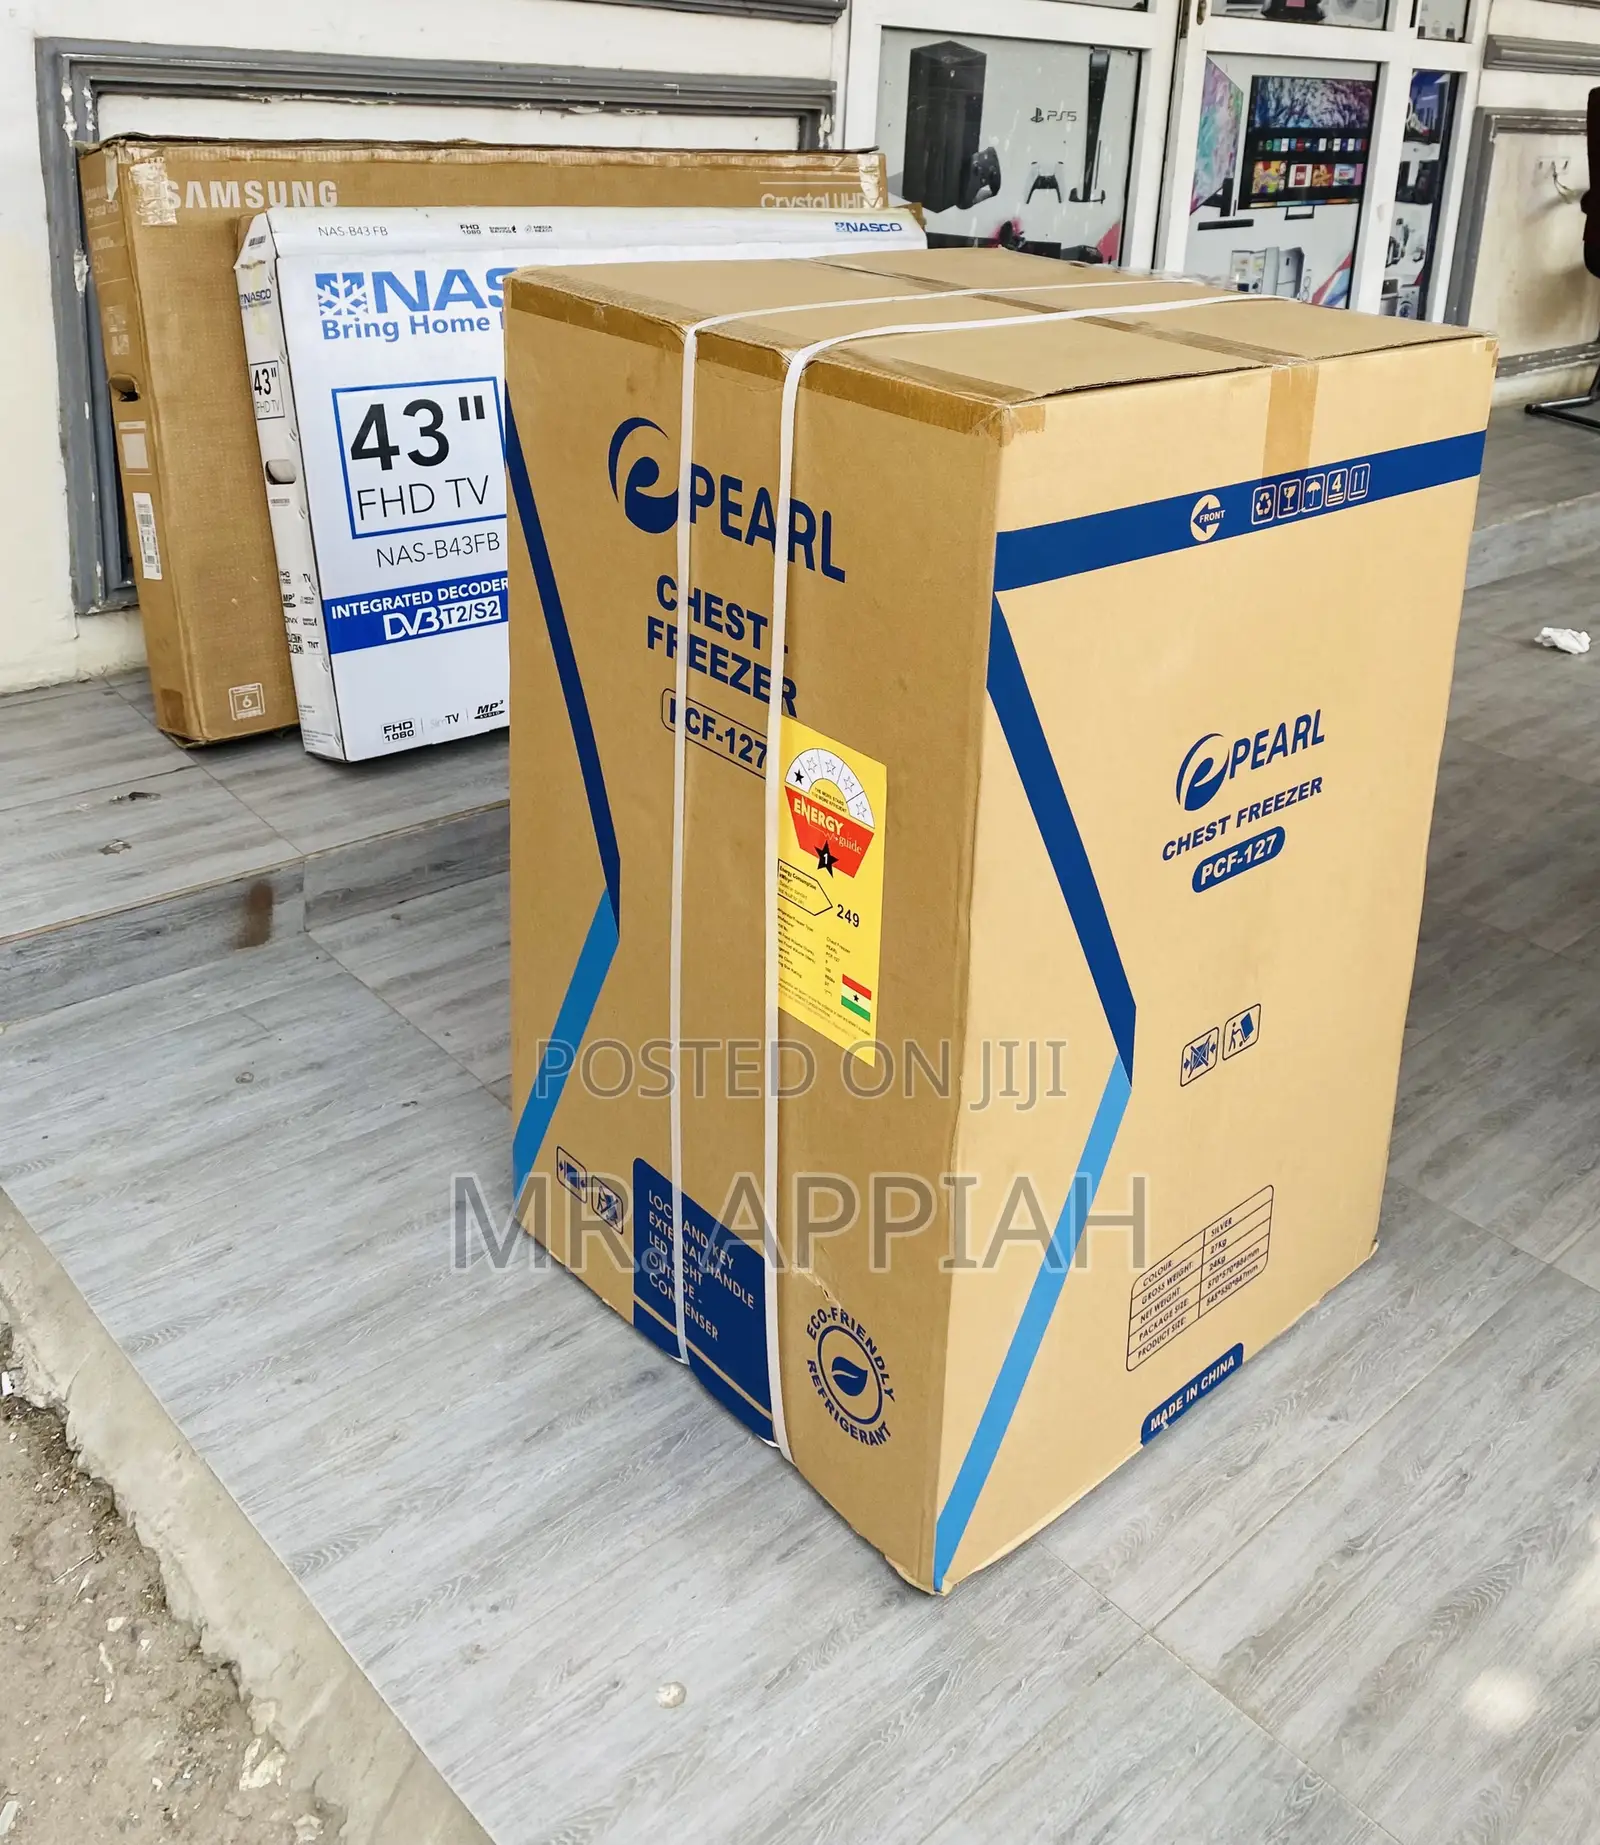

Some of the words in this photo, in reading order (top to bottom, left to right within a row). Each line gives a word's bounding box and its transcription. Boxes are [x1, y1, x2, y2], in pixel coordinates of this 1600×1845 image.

[1047, 110, 1077, 122] PS5
[165, 180, 338, 209] SAMSUNG
[846, 222, 902, 232] NASCO
[243, 289, 272, 304] NASCO
[321, 317, 400, 343] Bring
[409, 315, 491, 336] Home
[254, 367, 277, 396] 43"
[350, 395, 486, 471] 43"
[357, 483, 435, 520] FHD
[445, 475, 489, 508] TV
[1199, 509, 1226, 524] FRONT
[689, 462, 846, 584] PEARL
[376, 531, 500, 568] NAS-B43FB
[331, 590, 433, 620] INTEGRATED
[438, 577, 508, 602] DECODER
[382, 606, 441, 640] DVB
[443, 600, 499, 625] T2/S2
[383, 720, 413, 735] FHD
[384, 729, 415, 742] 1080
[1228, 709, 1326, 780] PEARL
[794, 796, 844, 836] ENERGY
[1162, 815, 1231, 861] CHEST
[1236, 776, 1323, 829] FREEZER
[823, 853, 829, 865] 1
[838, 836, 862, 855] guide
[1200, 833, 1277, 885] PCF-127
[837, 904, 860, 928] 249
[648, 1189, 673, 1220] LOC
[683, 1220, 709, 1249] AND
[712, 1242, 735, 1270] KEY
[648, 1230, 669, 1256] LED
[1211, 1216, 1232, 1237] SILVER
[648, 1210, 703, 1267] EXTENAL
[706, 1259, 755, 1310] HANDLE
[1141, 1281, 1166, 1306] GROSS
[1210, 1238, 1227, 1255] 27Kg
[649, 1272, 719, 1342] CONENSER
[1140, 1308, 1153, 1325] NET
[1209, 1255, 1226, 1272] 24Kg
[1137, 1327, 1171, 1359] PRODUCT
[1139, 1309, 1174, 1342] PACKAGE
[806, 1306, 896, 1403] ECO-FRIENDLY
[806, 1359, 892, 1446] REFRIGERANT
[1150, 1395, 1184, 1432] MADE
[1186, 1383, 1198, 1403] IN
[1200, 1355, 1235, 1390] CHINA
